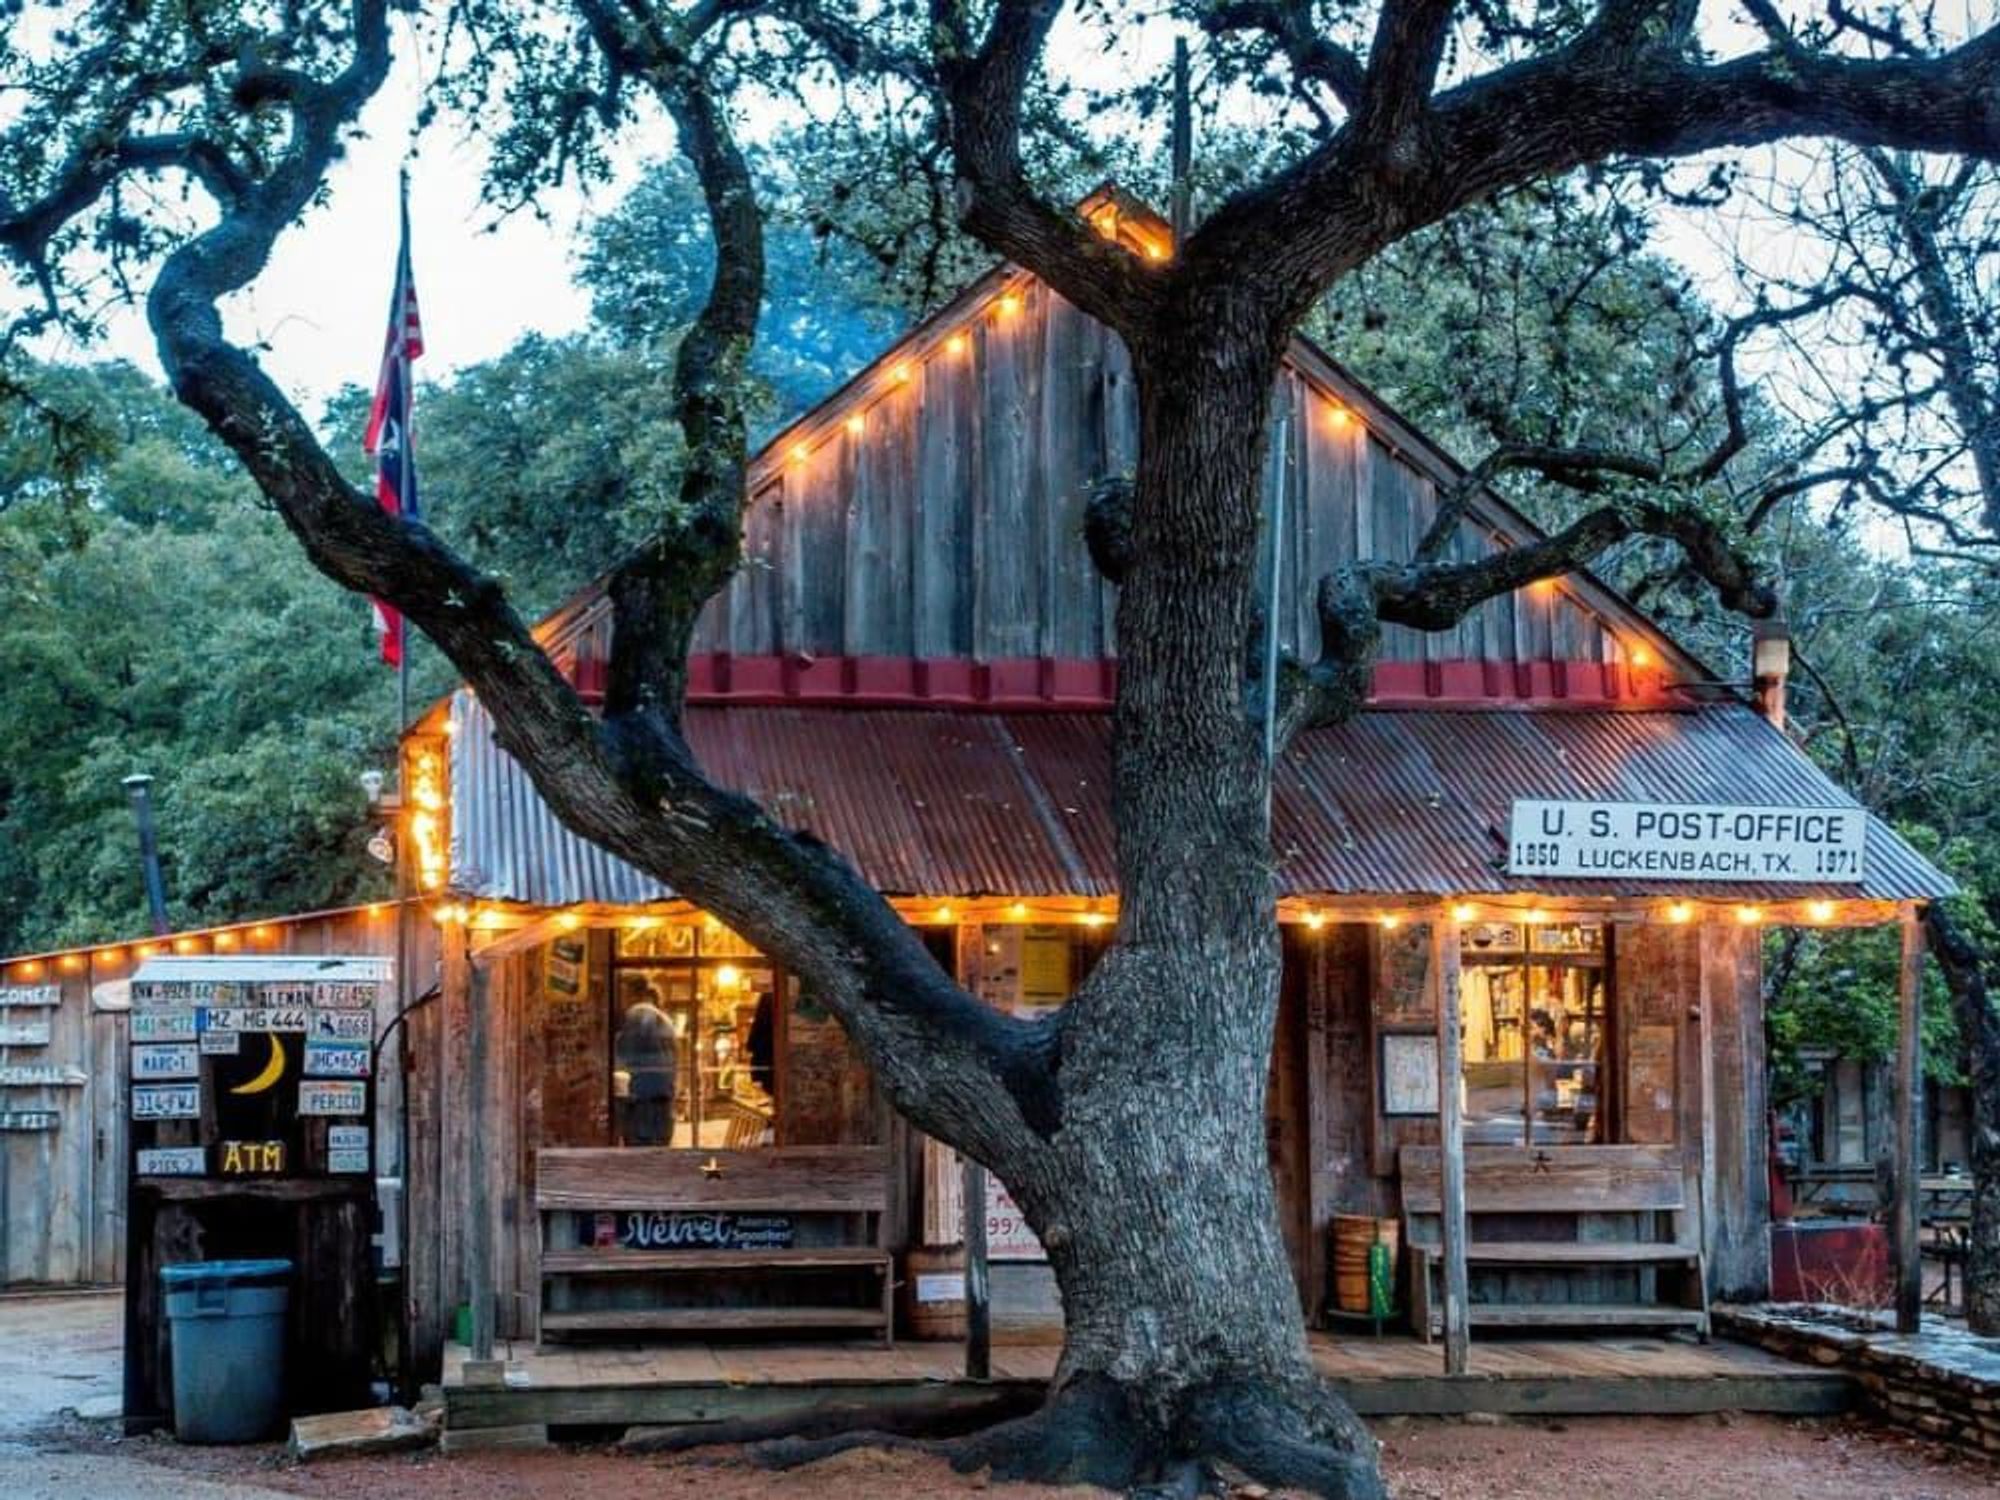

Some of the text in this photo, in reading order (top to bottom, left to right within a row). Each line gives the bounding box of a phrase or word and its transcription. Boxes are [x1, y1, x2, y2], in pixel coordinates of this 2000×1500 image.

[1542, 808, 1844, 844] U. S. POST-OFFICE
[1816, 850, 1857, 874] 1971
[207, 1010, 231, 1028] MZ
[243, 1010, 267, 1027] MG
[271, 1010, 305, 1027] 444
[223, 1140, 282, 1173] ATM
